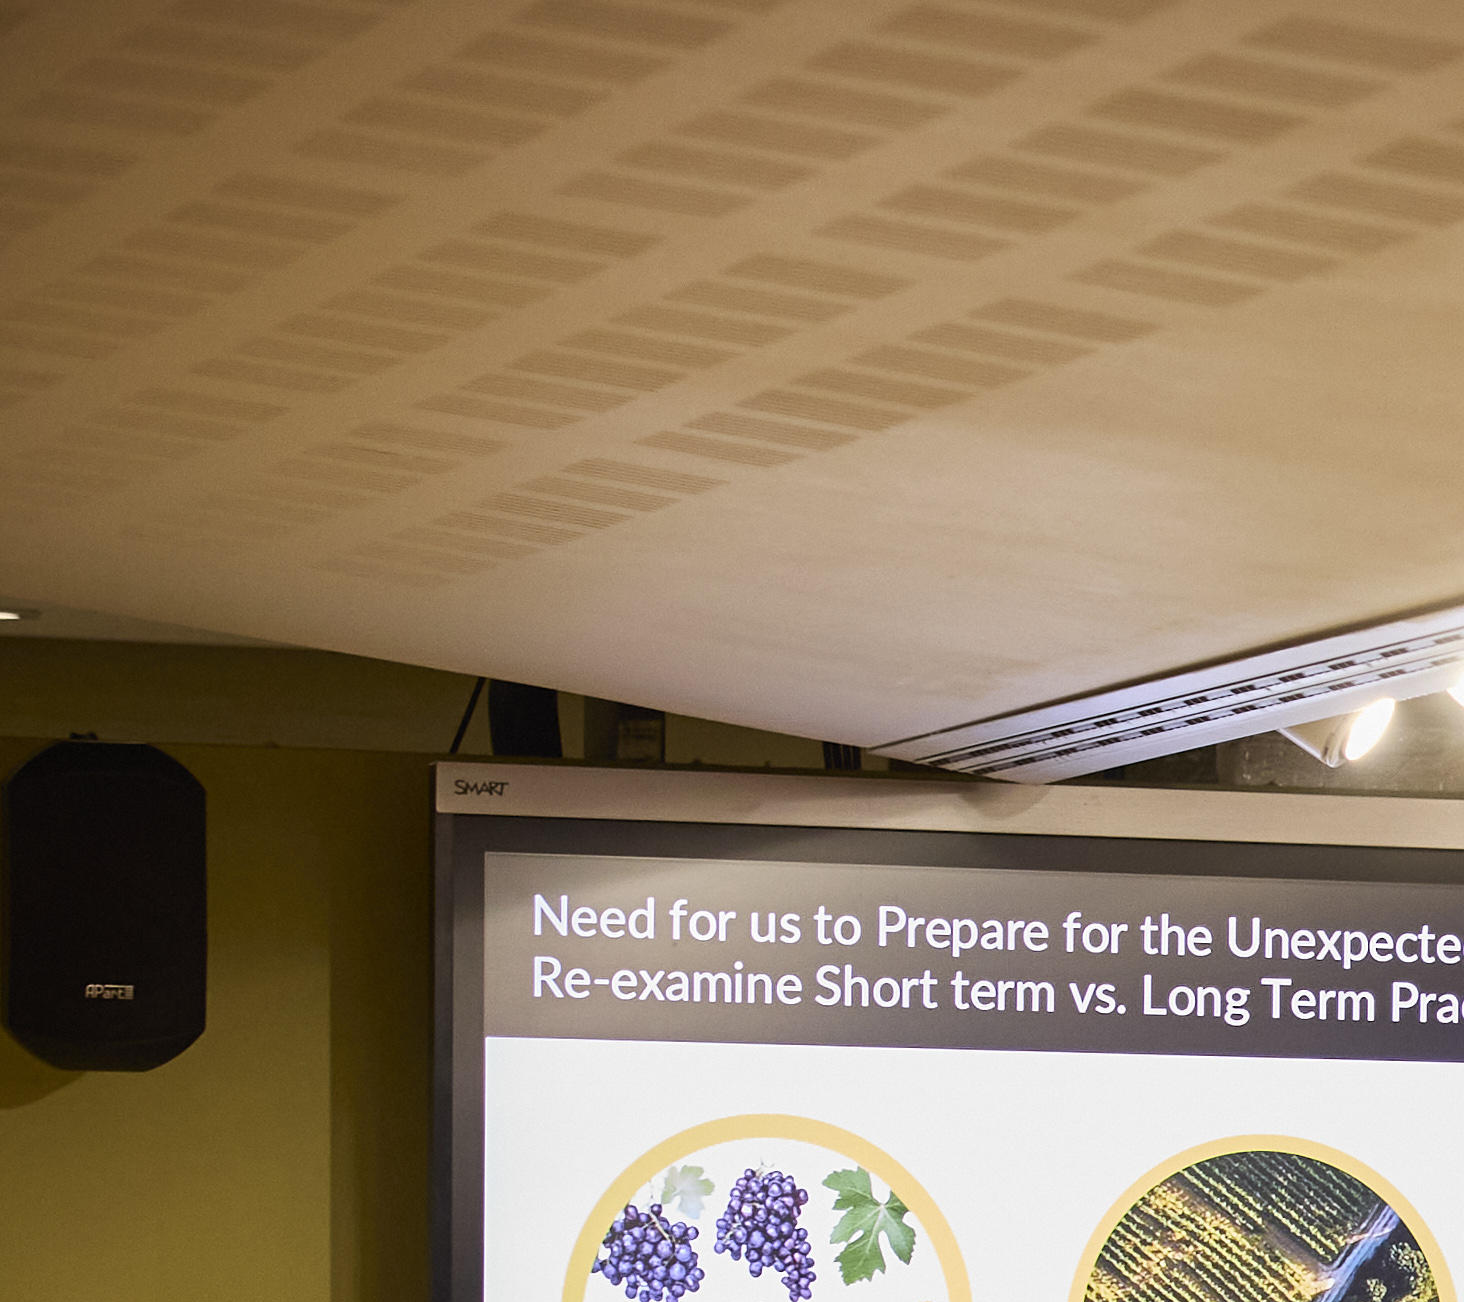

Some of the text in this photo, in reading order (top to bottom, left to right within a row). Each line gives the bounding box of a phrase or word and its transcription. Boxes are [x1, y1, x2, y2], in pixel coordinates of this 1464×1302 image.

[454, 779, 509, 796] SMART
[533, 893, 656, 940] Need
[667, 898, 737, 942] for
[750, 911, 802, 944] us
[812, 905, 862, 946] to
[878, 905, 1049, 958] Prepare
[1062, 911, 1129, 954] for
[1139, 913, 1213, 957] the
[533, 955, 803, 1005] Re-examine
[814, 963, 939, 1009] Short
[950, 970, 1055, 1013] term
[1068, 982, 1127, 1015] vs.
[1143, 974, 1251, 1027] Long
[1260, 977, 1375, 1022] Term
